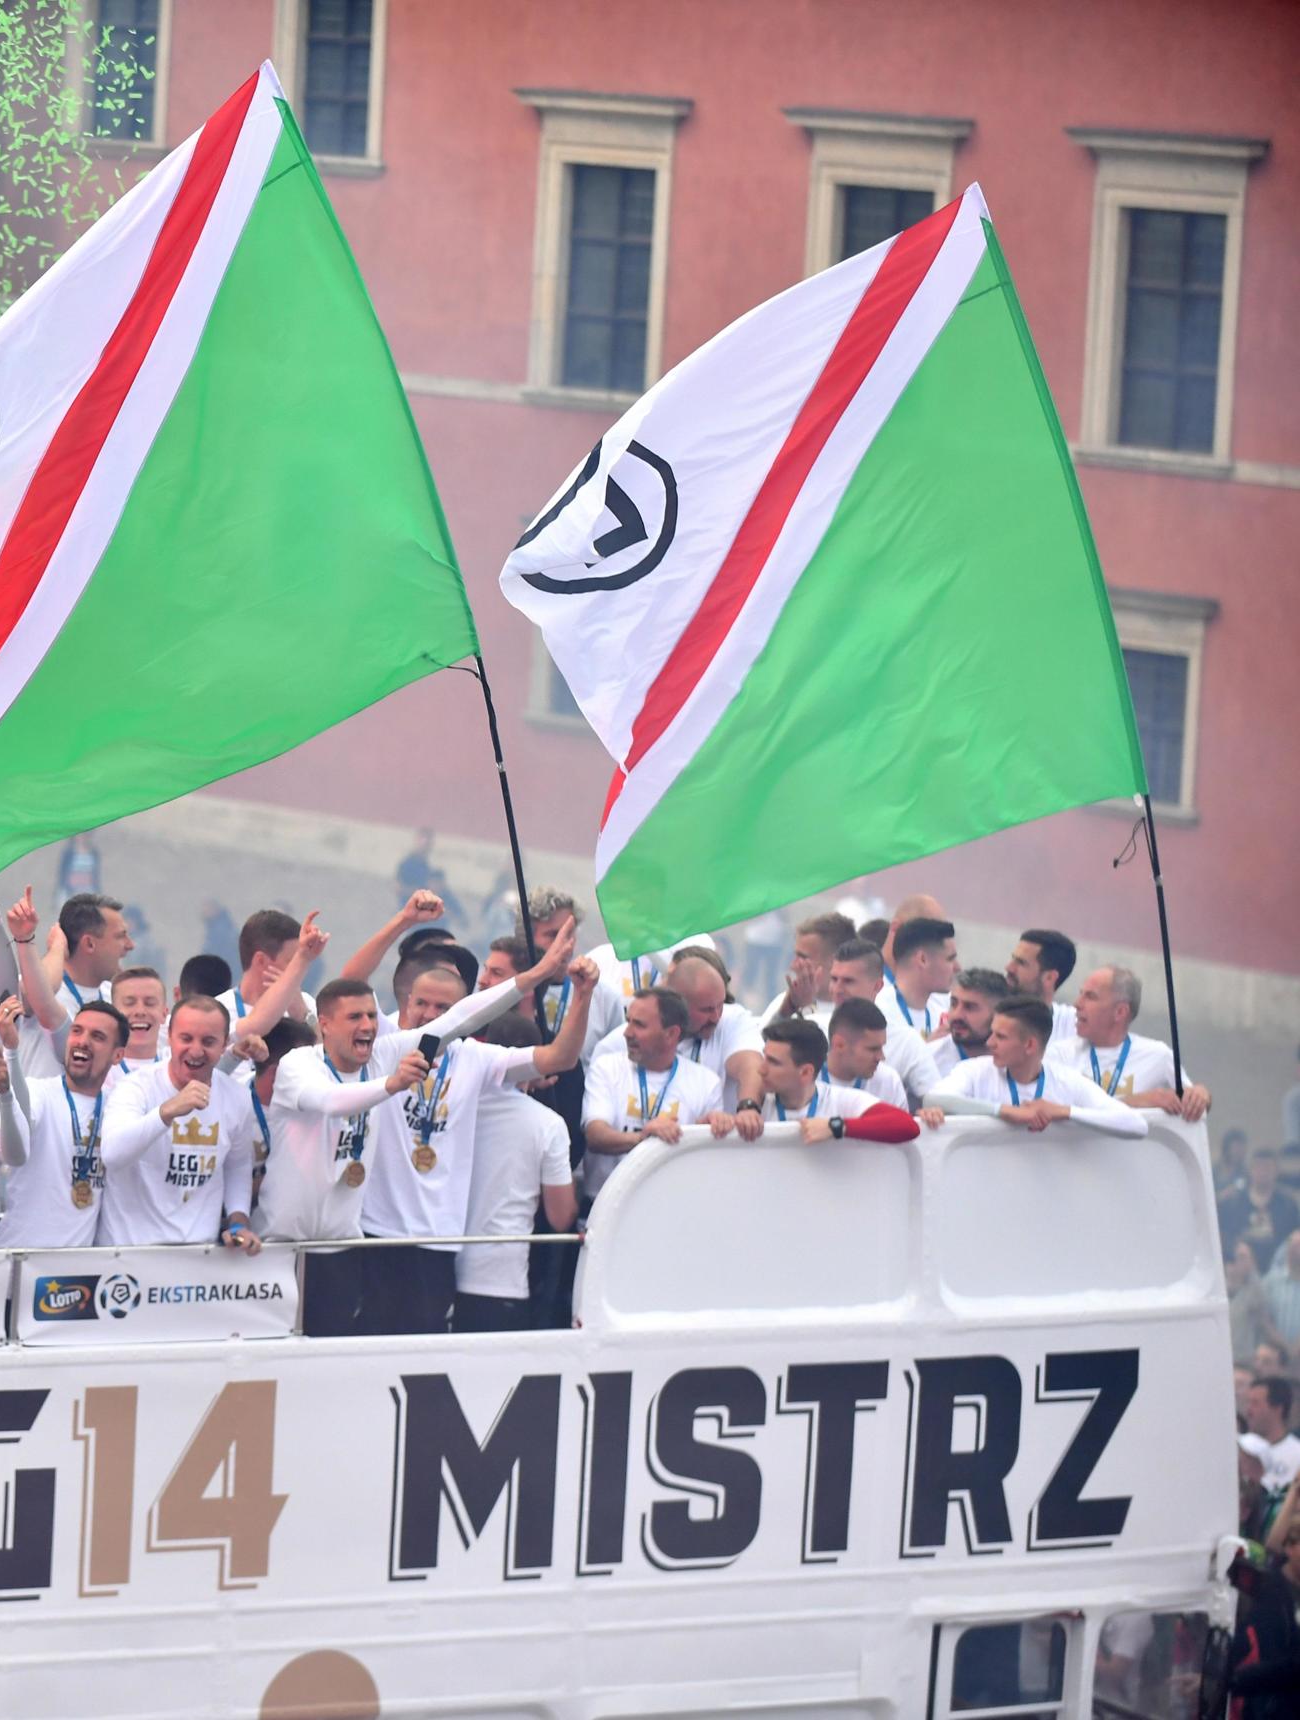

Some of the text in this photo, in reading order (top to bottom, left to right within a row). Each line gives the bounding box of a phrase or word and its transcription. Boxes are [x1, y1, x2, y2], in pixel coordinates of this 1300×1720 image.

[404, 1095, 449, 1118] LE4
[169, 1152, 217, 1174] LEG14
[50, 1289, 81, 1309] LOTTO
[148, 1283, 284, 1304] EKSTRAKLASA
[389, 1347, 1141, 1582] MISTRZ
